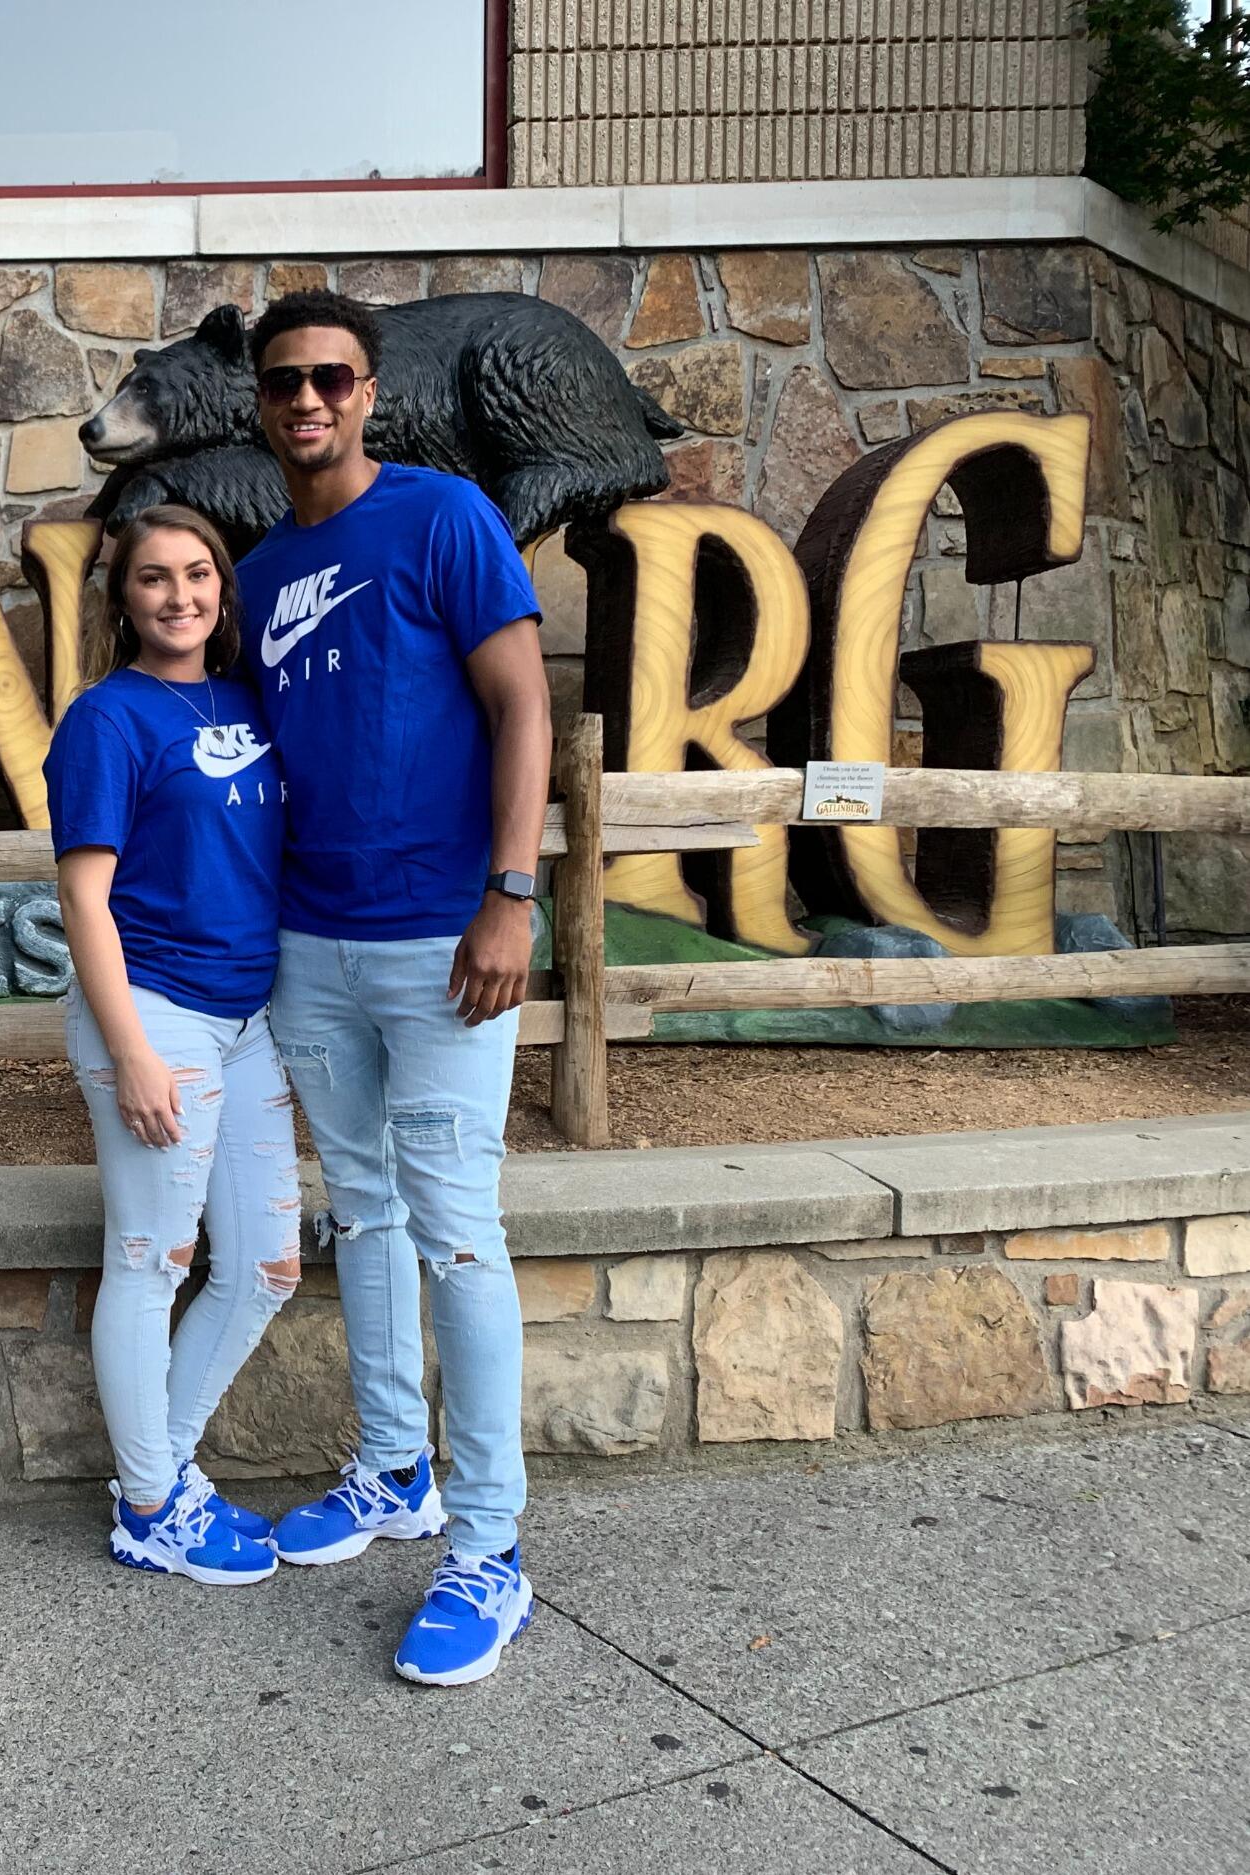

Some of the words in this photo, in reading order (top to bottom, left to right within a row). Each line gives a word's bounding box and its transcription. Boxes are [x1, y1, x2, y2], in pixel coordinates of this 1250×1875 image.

[270, 563, 342, 632] NIKE
[278, 648, 341, 692] AIR
[193, 723, 256, 759] NIKE
[816, 802, 868, 815] GATLINBURG
